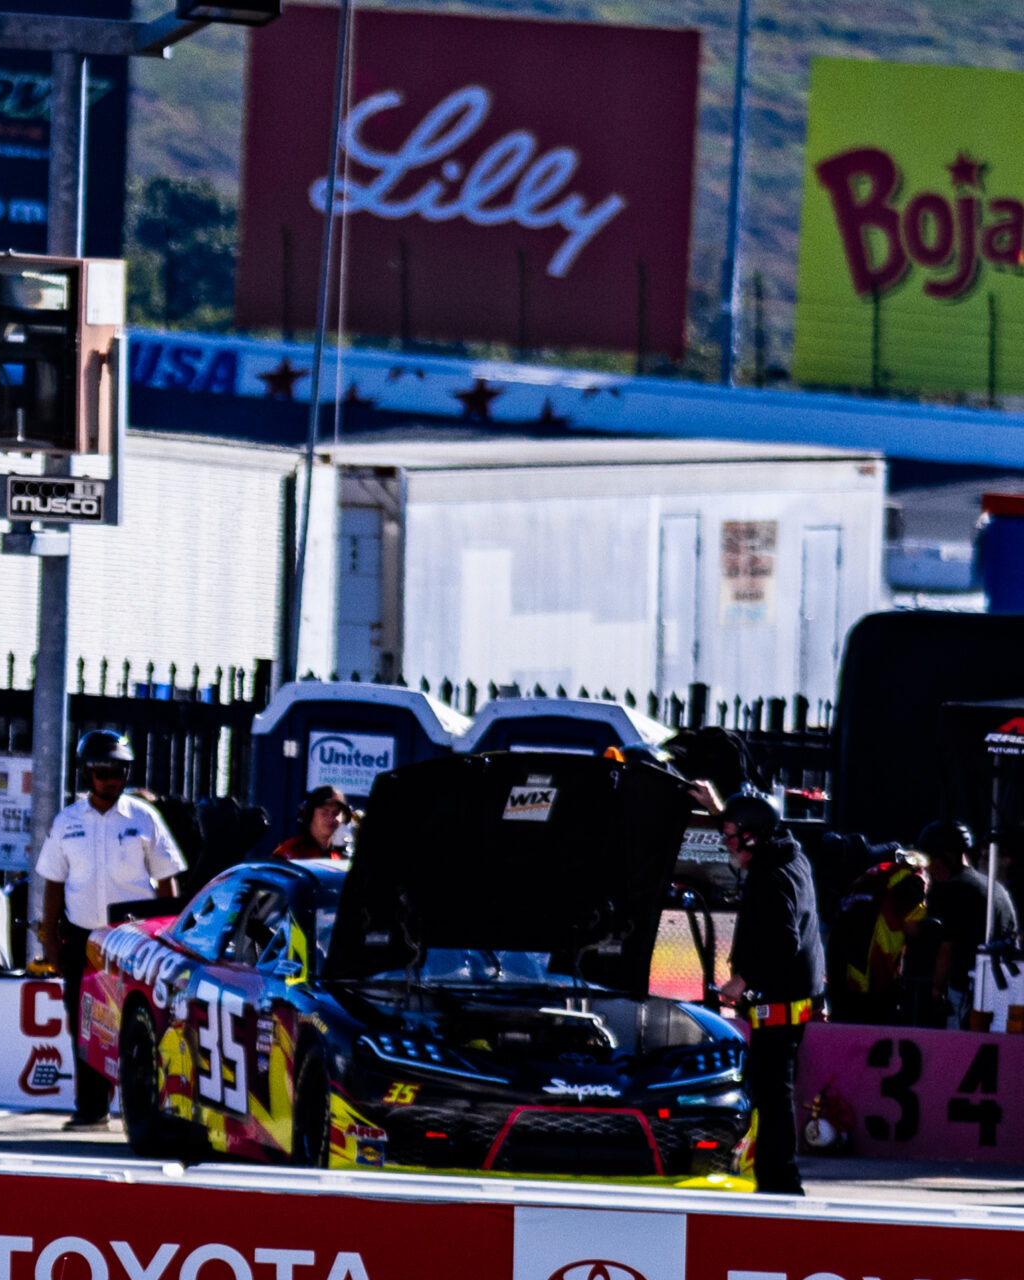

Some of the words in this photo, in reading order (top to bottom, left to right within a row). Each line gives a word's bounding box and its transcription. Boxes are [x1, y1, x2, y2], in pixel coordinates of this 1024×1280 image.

[309, 86, 626, 278] Lilly
[319, 747, 389, 769] United
[509, 789, 553, 808] WIX
[196, 978, 248, 1115] 35
[382, 1081, 421, 1105] 35
[543, 1078, 621, 1101] Supra
